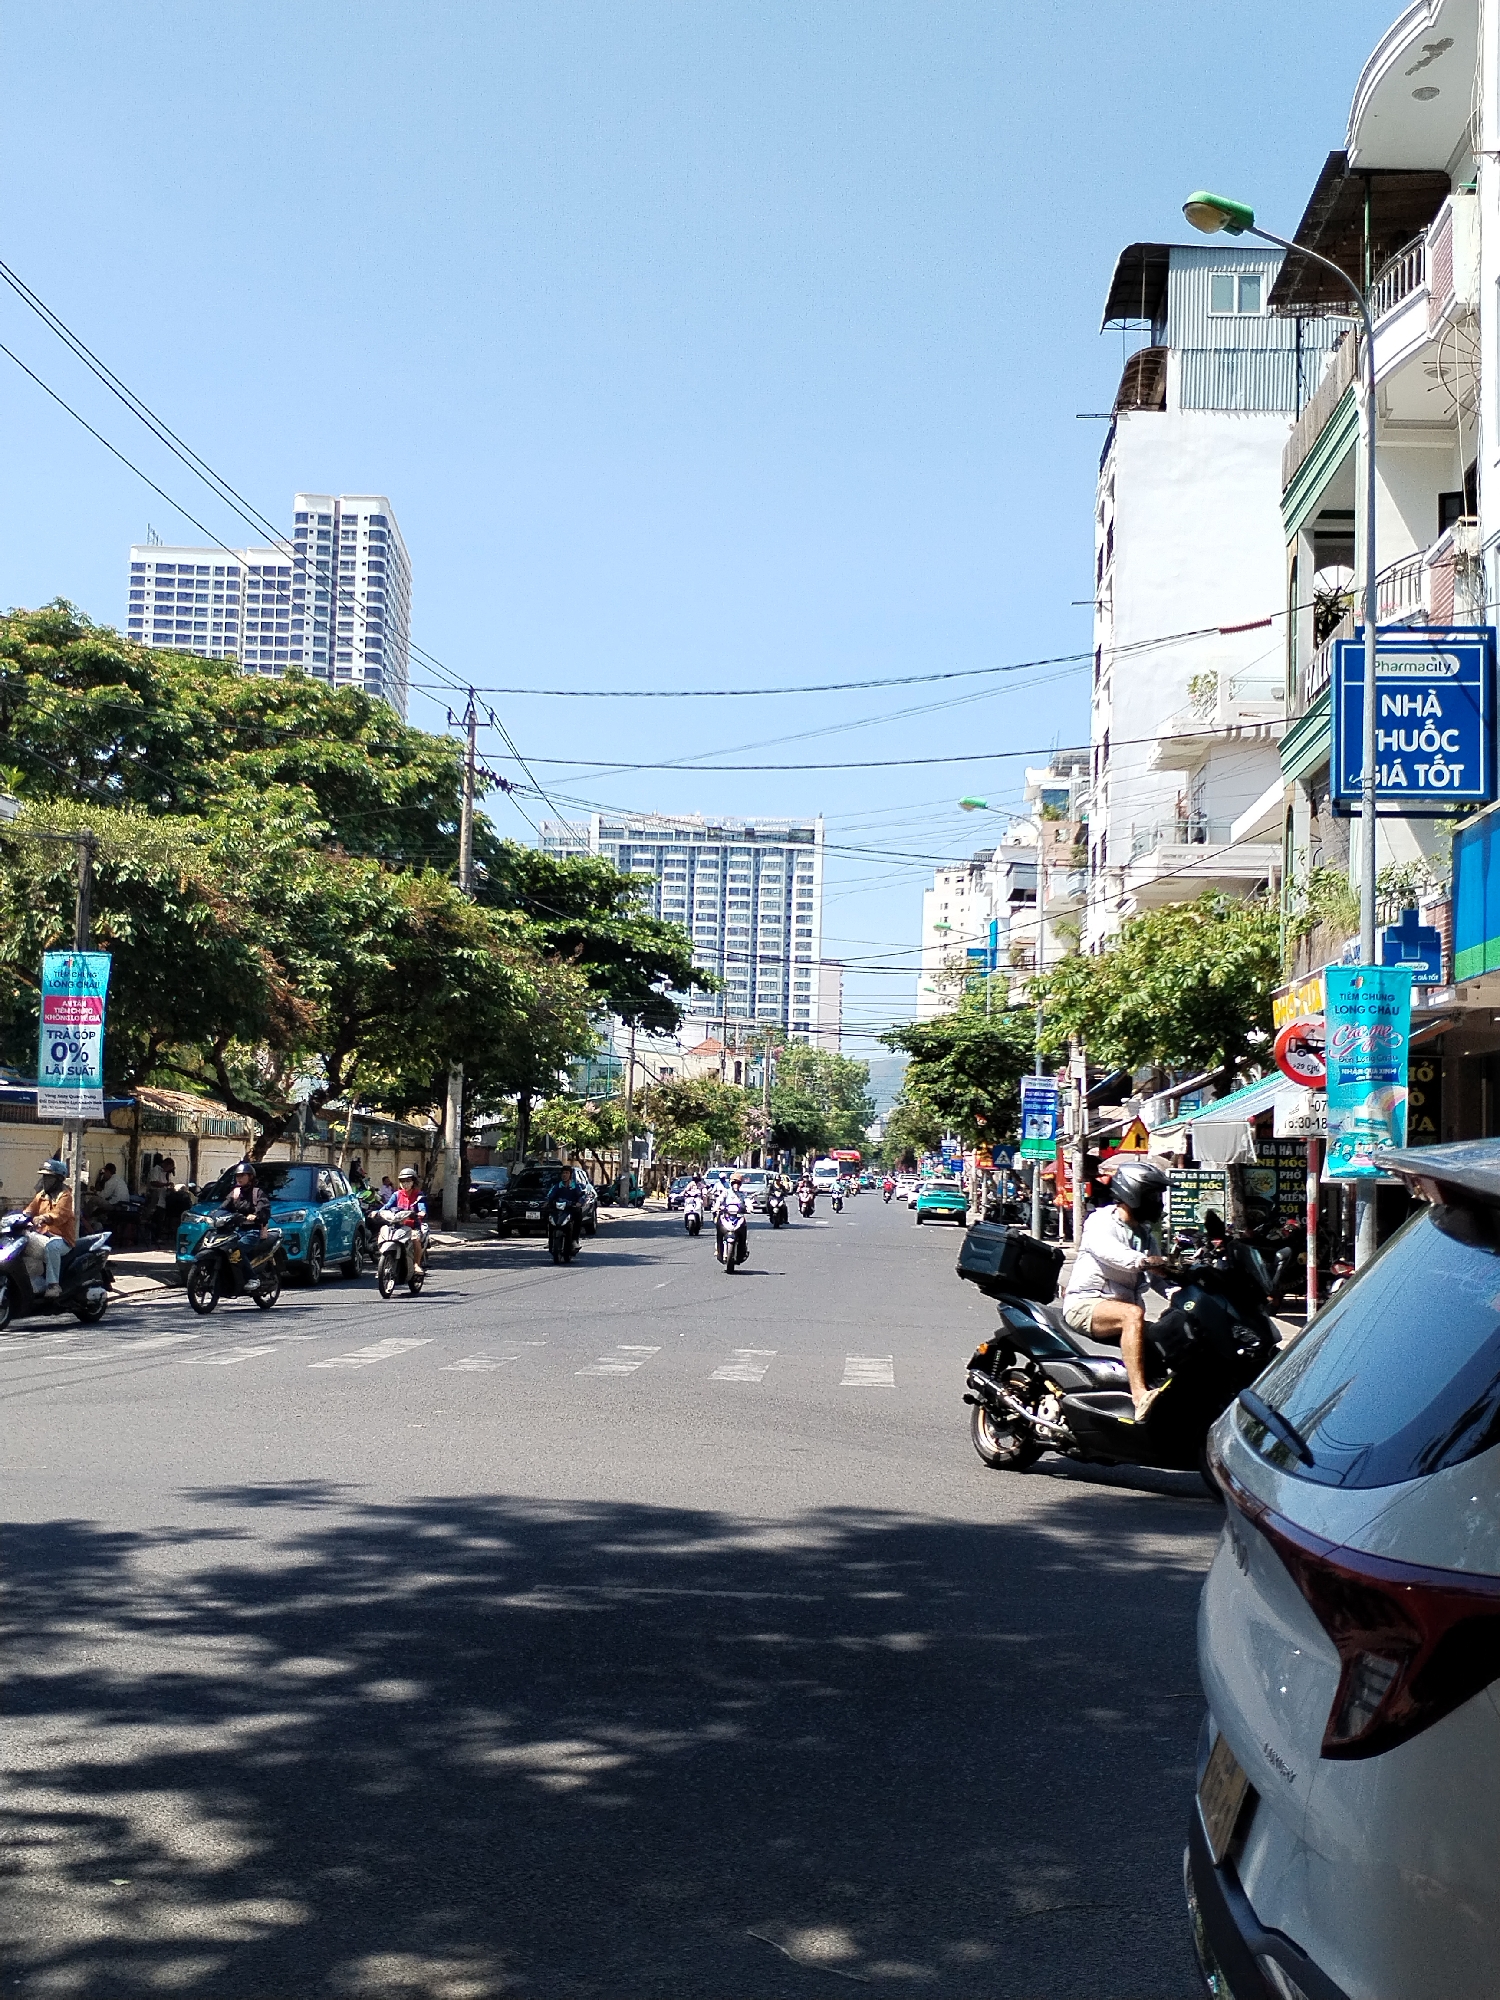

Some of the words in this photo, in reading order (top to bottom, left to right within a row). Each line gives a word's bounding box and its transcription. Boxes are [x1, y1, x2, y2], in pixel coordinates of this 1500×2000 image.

[1381, 688, 1443, 718] NHÀ
[1375, 719, 1460, 752] HUỐC
[1414, 753, 1465, 788] TỐT
[49, 980, 74, 988] LONG
[1339, 991, 1360, 1001] TIÊM
[1335, 1004, 1366, 1014] LONG
[1368, 1002, 1400, 1015] CHÂU
[51, 1042, 89, 1063] 0%
[1262, 1143, 1276, 1156] GÀ
[1279, 1143, 1293, 1156] HÀ
[1295, 1143, 1308, 1158] NỘ
[1279, 1156, 1307, 1168] MỐC
[1279, 1169, 1302, 1179] PHỞ
[1180, 1181, 1197, 1189] NH
[1199, 1180, 1223, 1189] MỐC
[1292, 1180, 1307, 1191] XÀ
[1279, 1203, 1299, 1215] XÔI
[1279, 1214, 1308, 1225] CÁO
